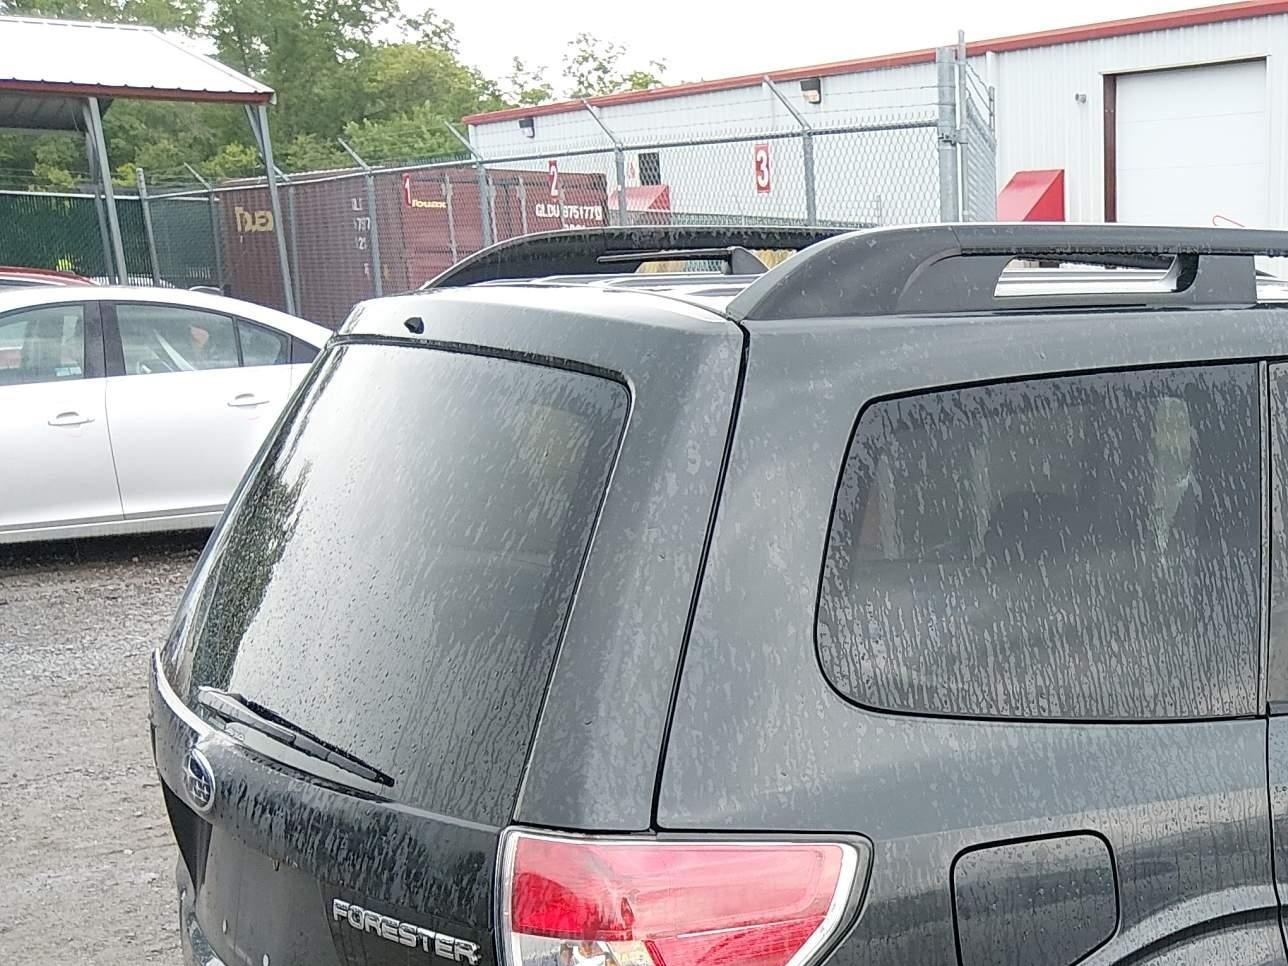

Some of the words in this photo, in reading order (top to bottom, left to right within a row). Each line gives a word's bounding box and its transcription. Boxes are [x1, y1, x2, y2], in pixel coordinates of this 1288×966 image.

[550, 165, 558, 197] 2
[756, 150, 770, 187] 3
[333, 898, 482, 966] FORESTER
